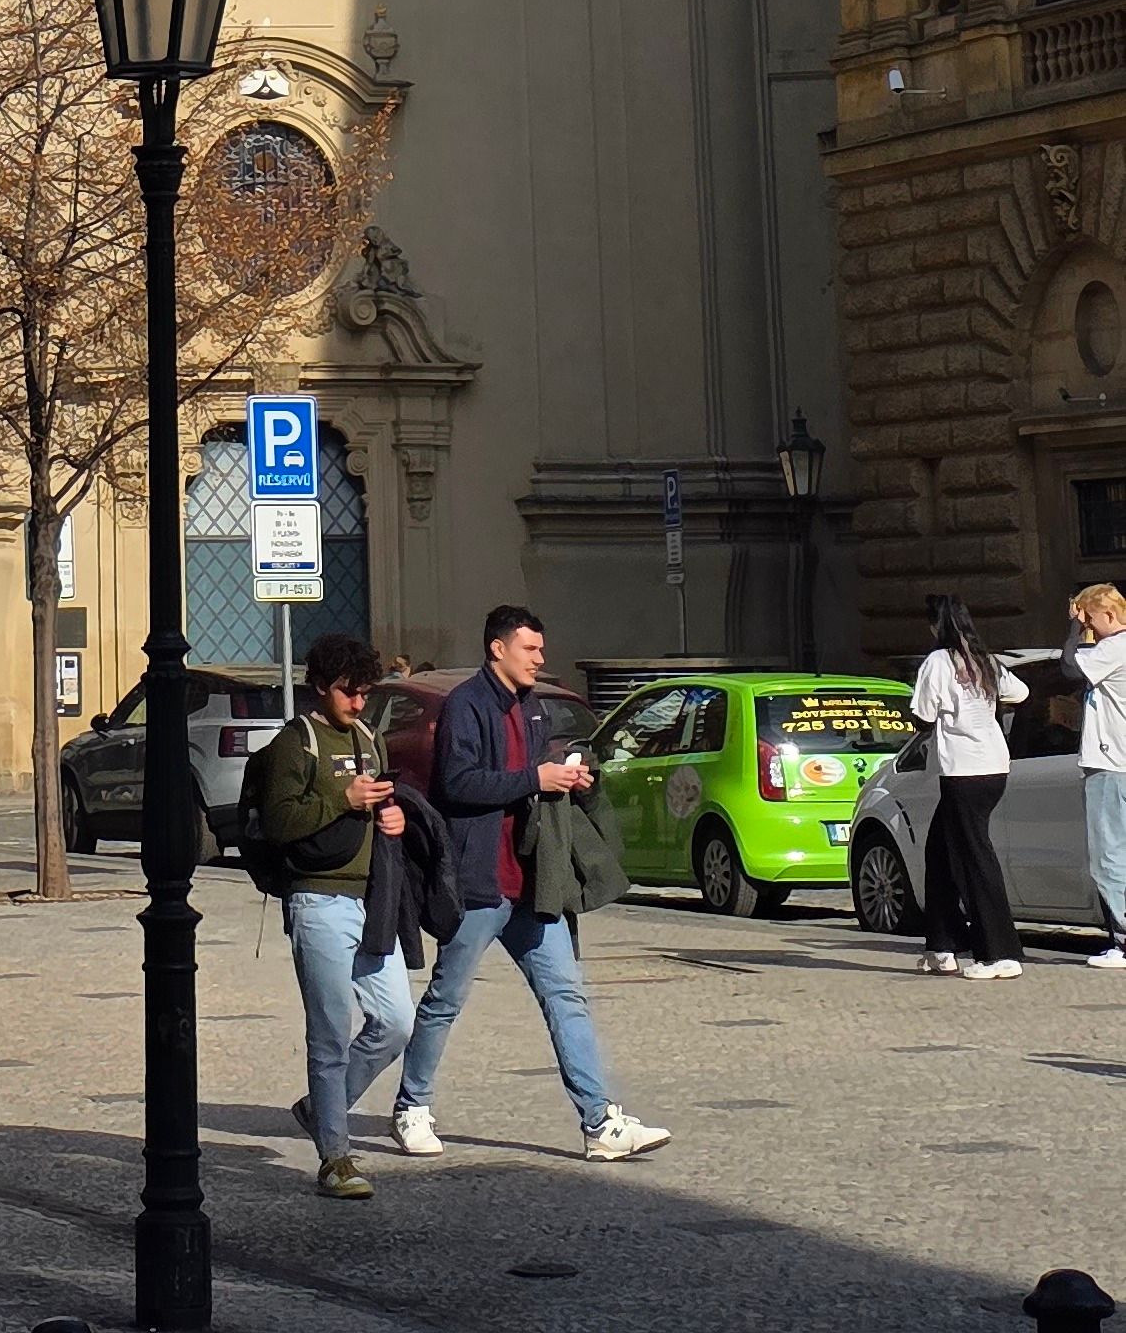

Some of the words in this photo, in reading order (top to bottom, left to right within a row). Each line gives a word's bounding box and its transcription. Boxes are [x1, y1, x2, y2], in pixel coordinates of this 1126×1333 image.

[264, 410, 302, 466] P
[782, 720, 825, 733] 725
[832, 719, 872, 730] 501
[878, 720, 916, 733] 501
